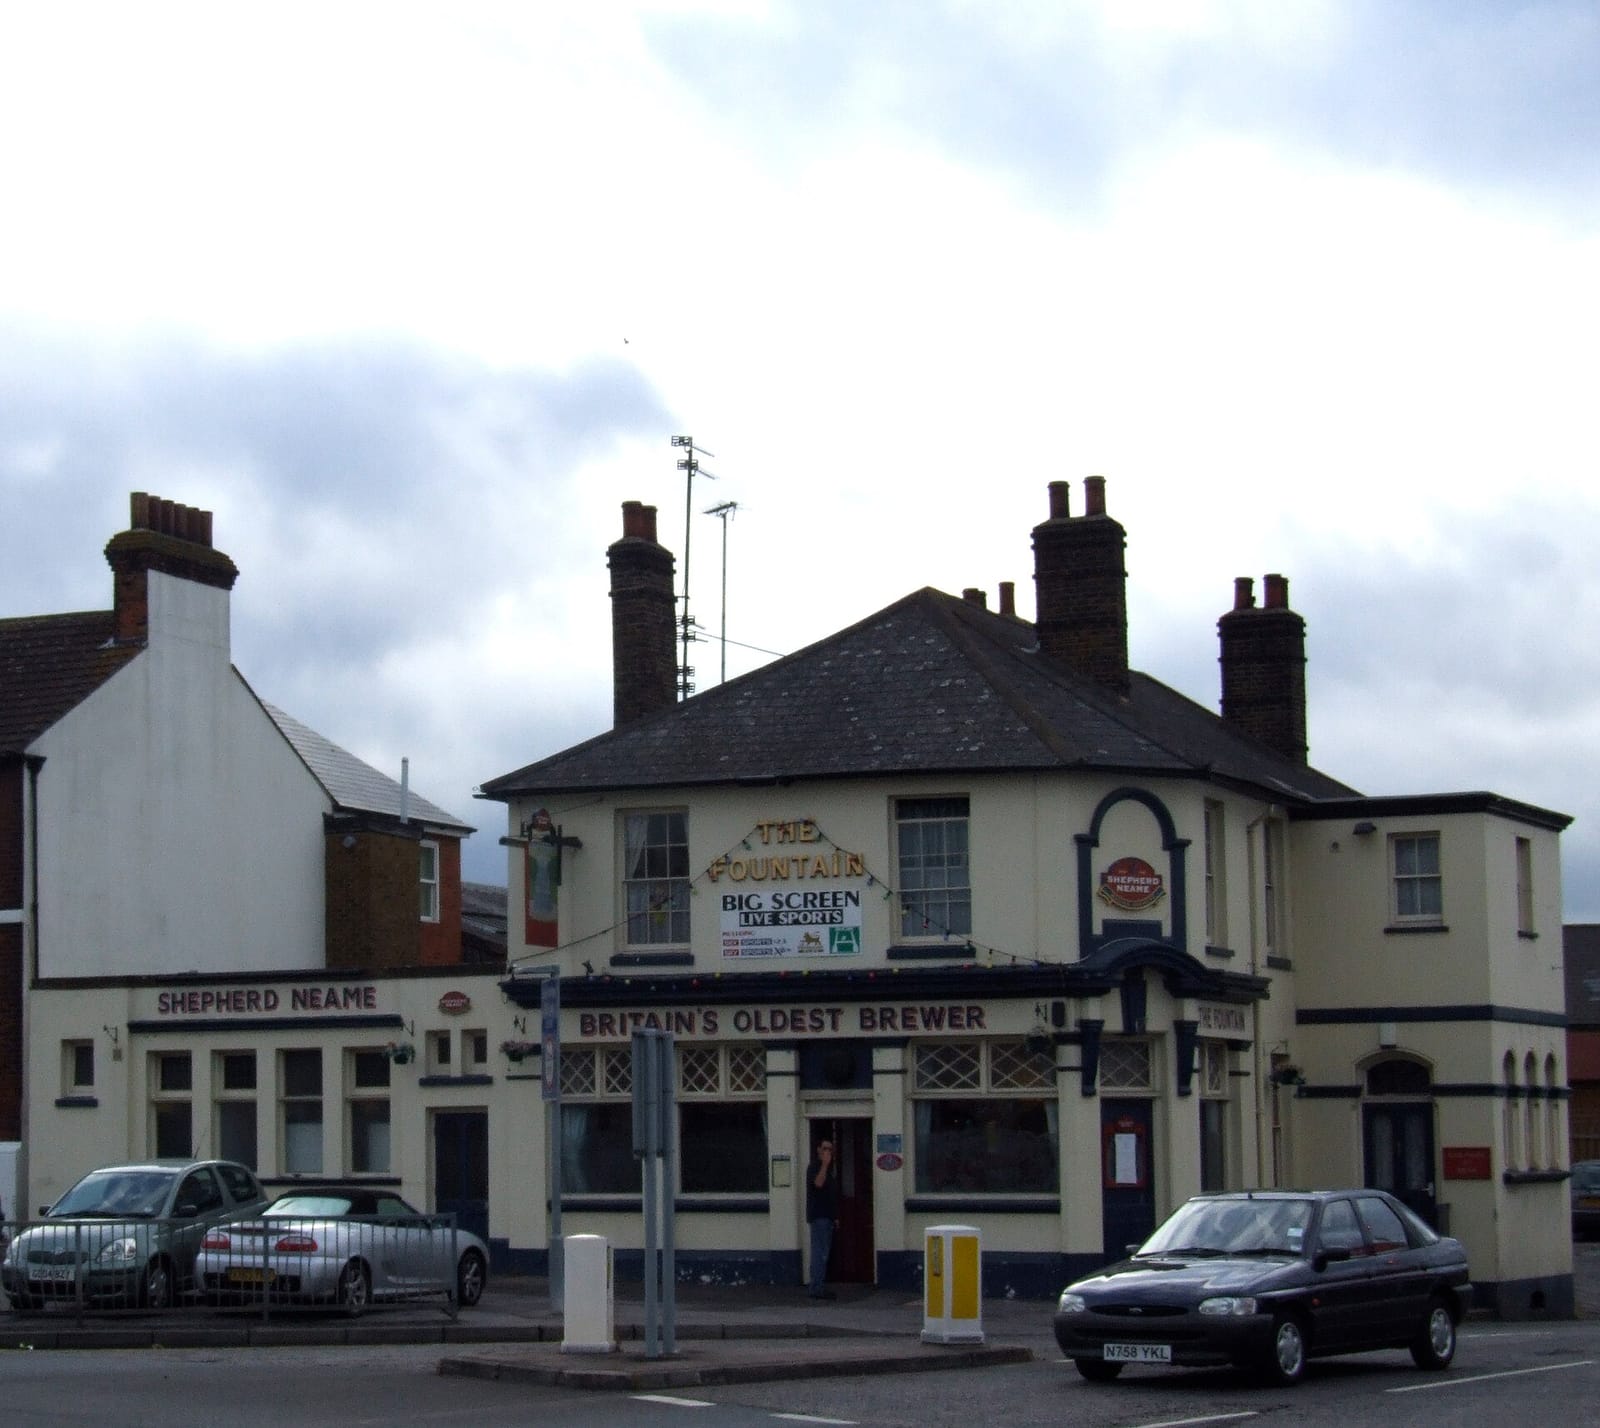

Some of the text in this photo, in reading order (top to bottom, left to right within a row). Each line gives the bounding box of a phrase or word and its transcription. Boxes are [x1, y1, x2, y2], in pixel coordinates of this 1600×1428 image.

[756, 817, 817, 845] THE
[708, 851, 865, 883] FOUNTAIN
[1107, 875, 1160, 885] SHEPHERD
[1116, 885, 1150, 893] NEAME
[722, 890, 860, 911] BIG SCREEN
[740, 910, 843, 926] LIVE SPORTS
[158, 986, 377, 1014] SHEPHERD NEAME
[581, 1005, 987, 1036] BRITAIN'S OLDEST BREWER
[1199, 1007, 1211, 1028] THE
[1106, 1346, 1169, 1359] N758 YKL
